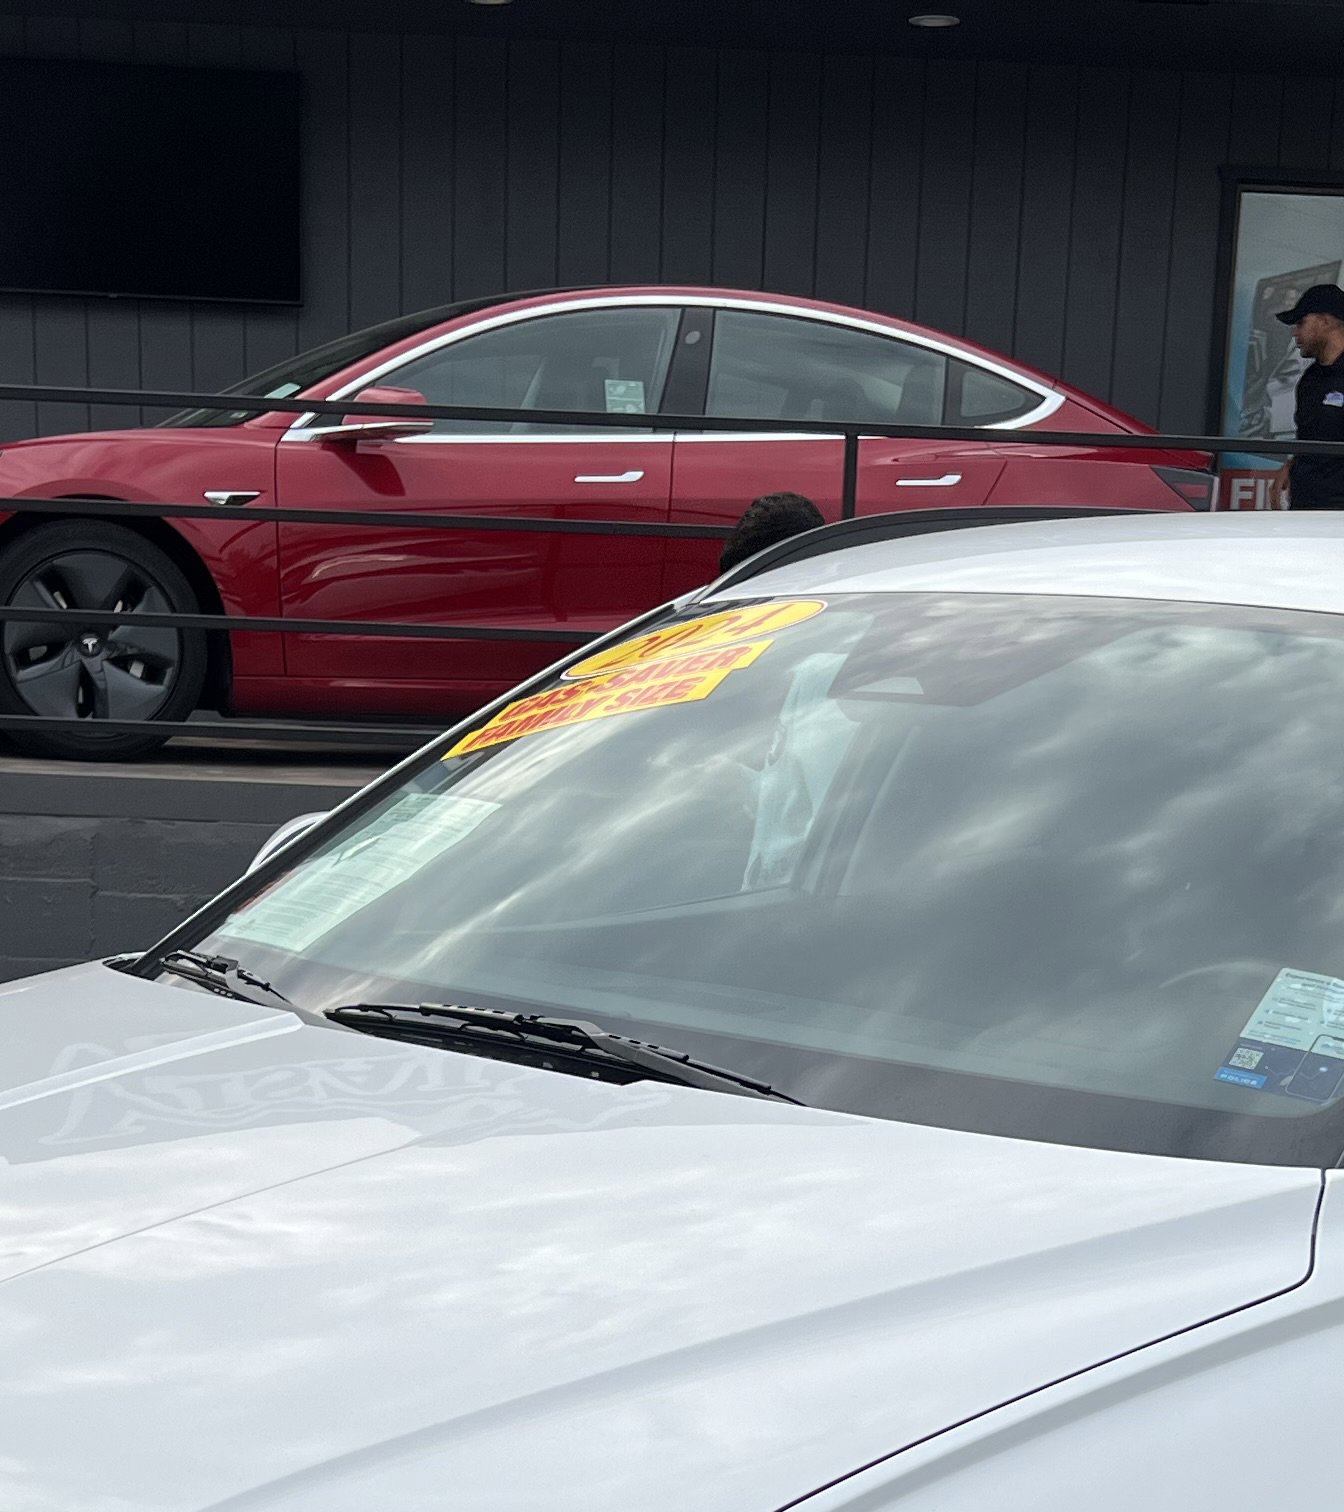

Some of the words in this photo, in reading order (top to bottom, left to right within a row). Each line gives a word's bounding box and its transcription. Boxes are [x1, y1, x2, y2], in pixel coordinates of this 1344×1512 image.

[599, 603, 796, 671] 2024
[462, 694, 612, 753] FAMILY
[604, 675, 708, 712] SIZE
